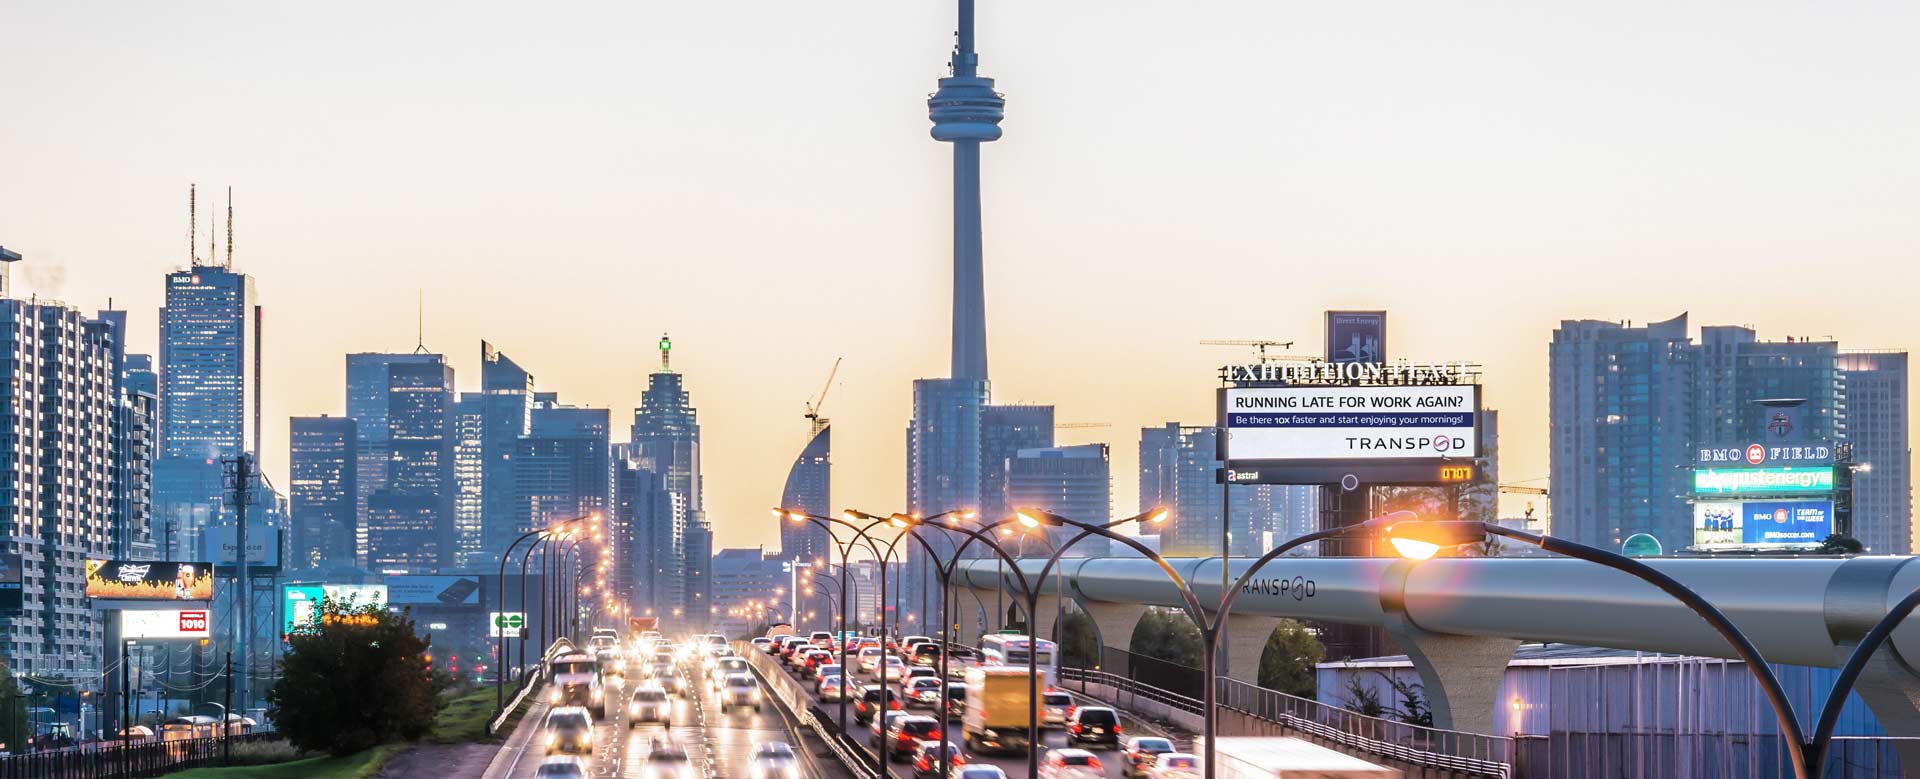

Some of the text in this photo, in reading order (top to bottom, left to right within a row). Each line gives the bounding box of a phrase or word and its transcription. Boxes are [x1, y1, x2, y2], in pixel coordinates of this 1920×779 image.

[1227, 361, 1383, 381] EXHIBITION
[1236, 396, 1464, 408] RUNNING LATE FOR WORK AGAIN?
[1236, 416, 1248, 424] Be
[1249, 415, 1273, 424] there
[1292, 415, 1317, 424] faster
[1319, 415, 1336, 424] and
[1338, 415, 1359, 424] start
[1360, 415, 1397, 426] enjoying
[1399, 417, 1418, 426] your
[1421, 415, 1464, 426] mornings!
[1701, 447, 1829, 461] BMO FIELD
[1237, 472, 1258, 480] astral
[181, 619, 205, 630] 1010
